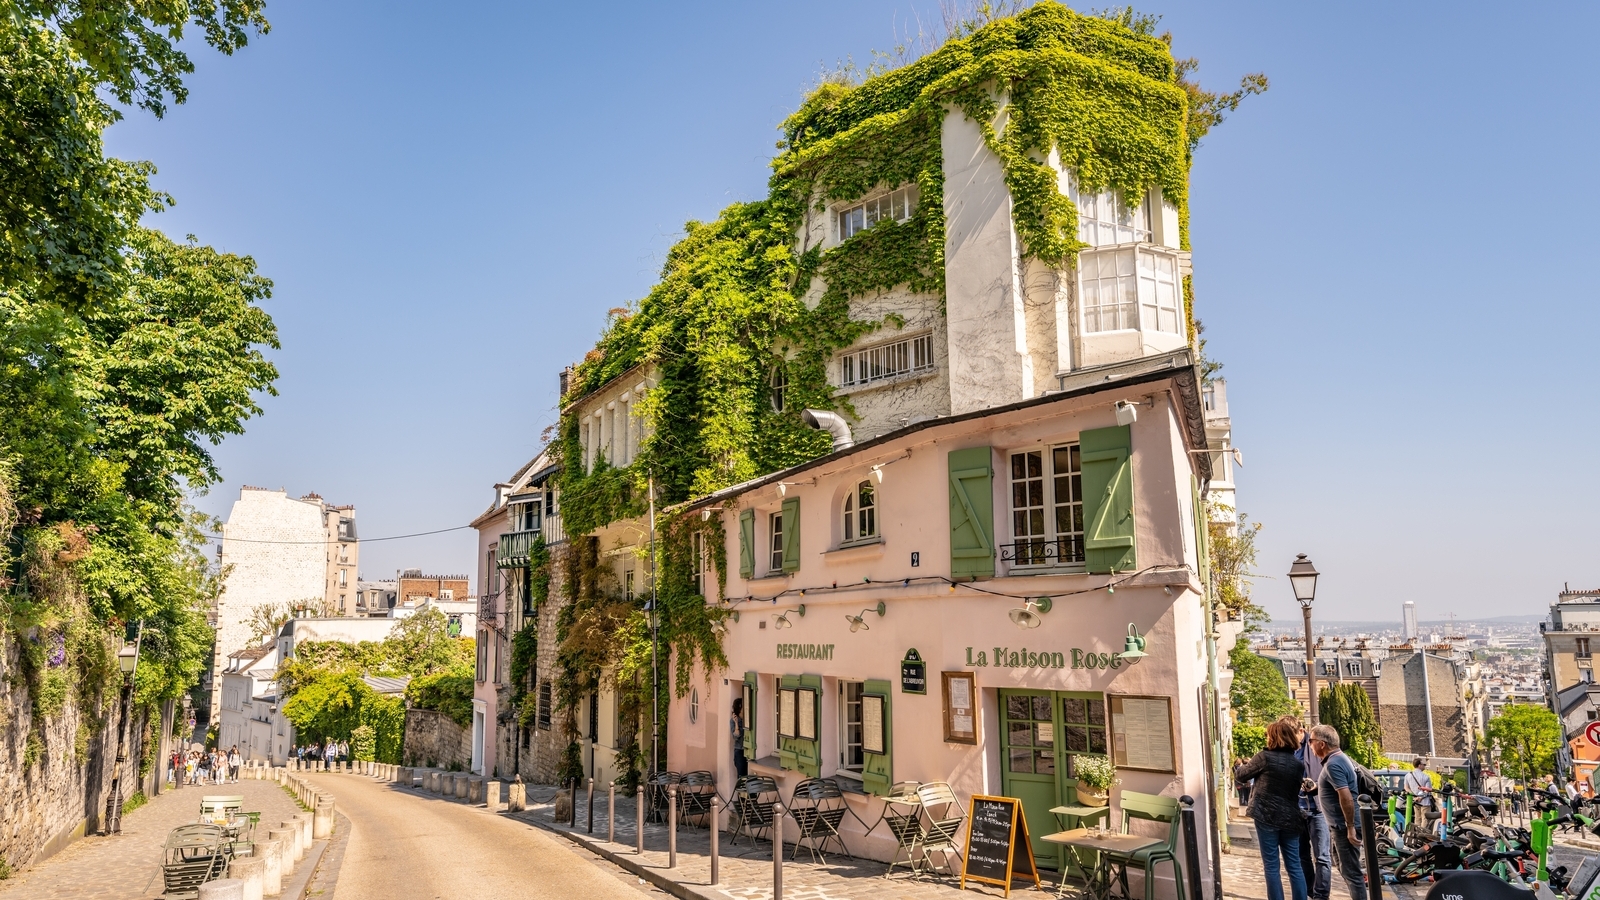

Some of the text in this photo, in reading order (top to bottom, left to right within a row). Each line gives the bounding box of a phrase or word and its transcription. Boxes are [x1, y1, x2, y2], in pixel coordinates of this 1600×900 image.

[776, 643, 835, 660] RESTAURANT
[965, 646, 1122, 669] La Maison Rose
